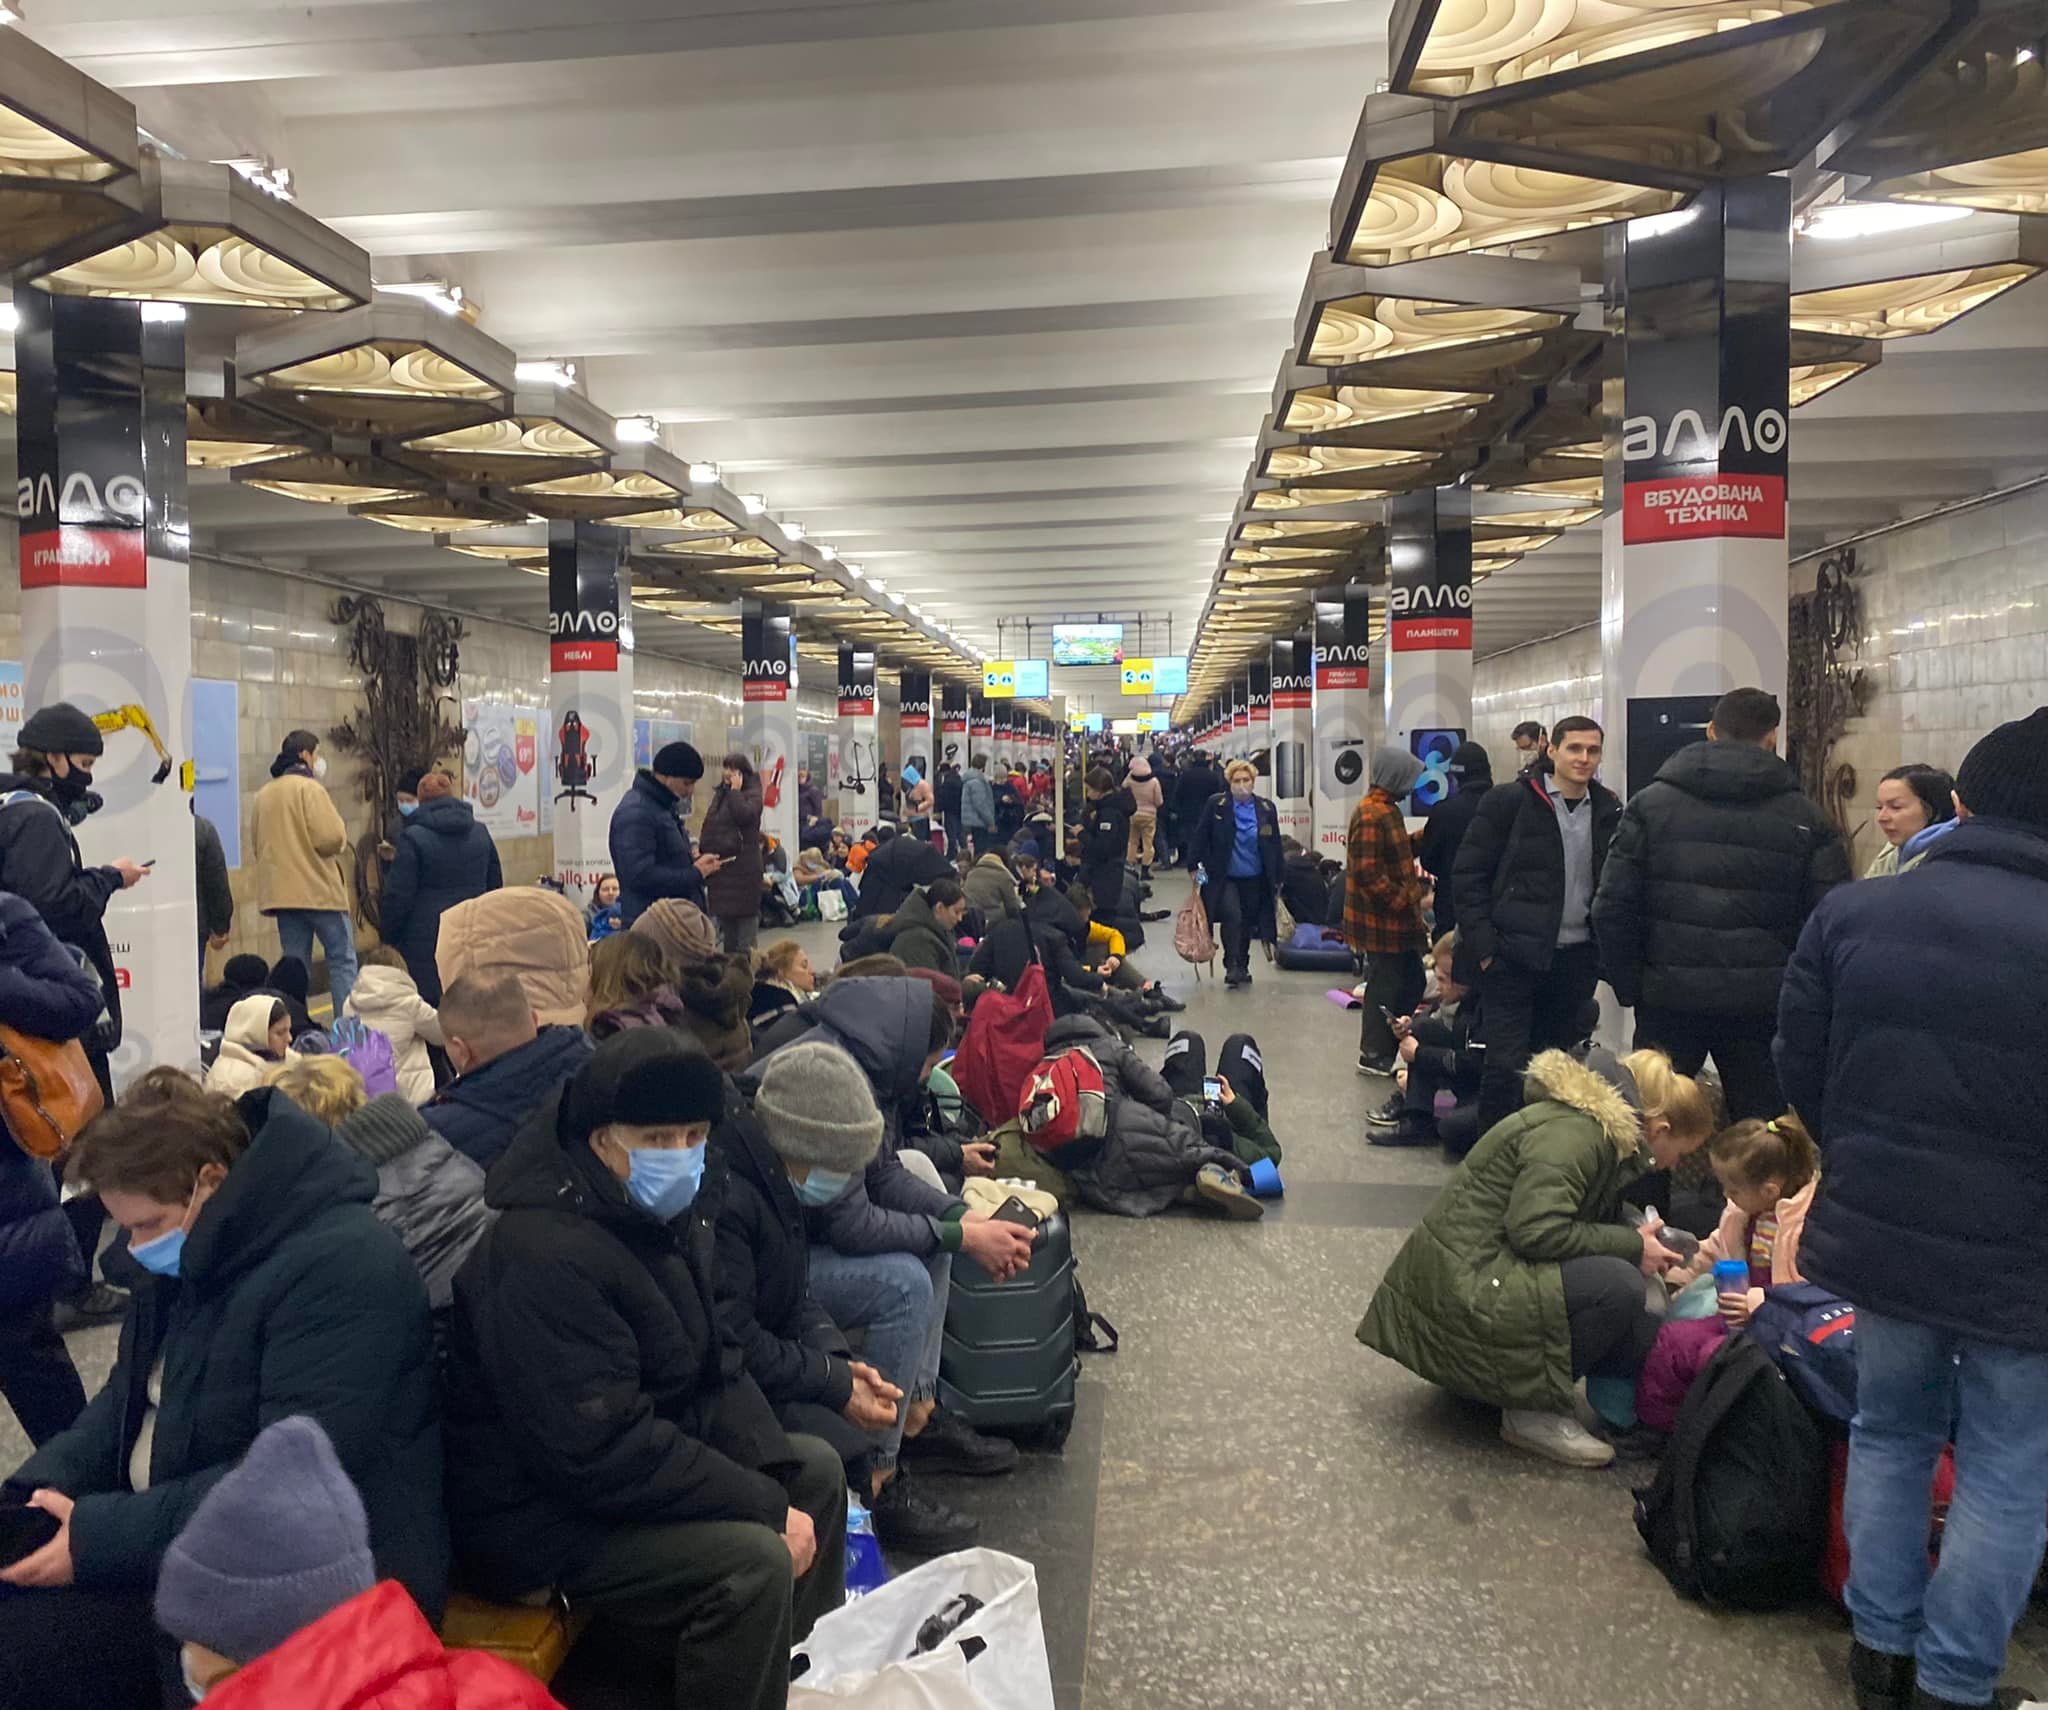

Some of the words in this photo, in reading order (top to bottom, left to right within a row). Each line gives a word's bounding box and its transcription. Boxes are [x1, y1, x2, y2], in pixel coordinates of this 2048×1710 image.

[1644, 485, 1763, 508] ВБУДОВАНА
[1665, 505, 1748, 525] ТЕХНІКА
[1406, 628, 1459, 638] ПЛАНШЕТИ
